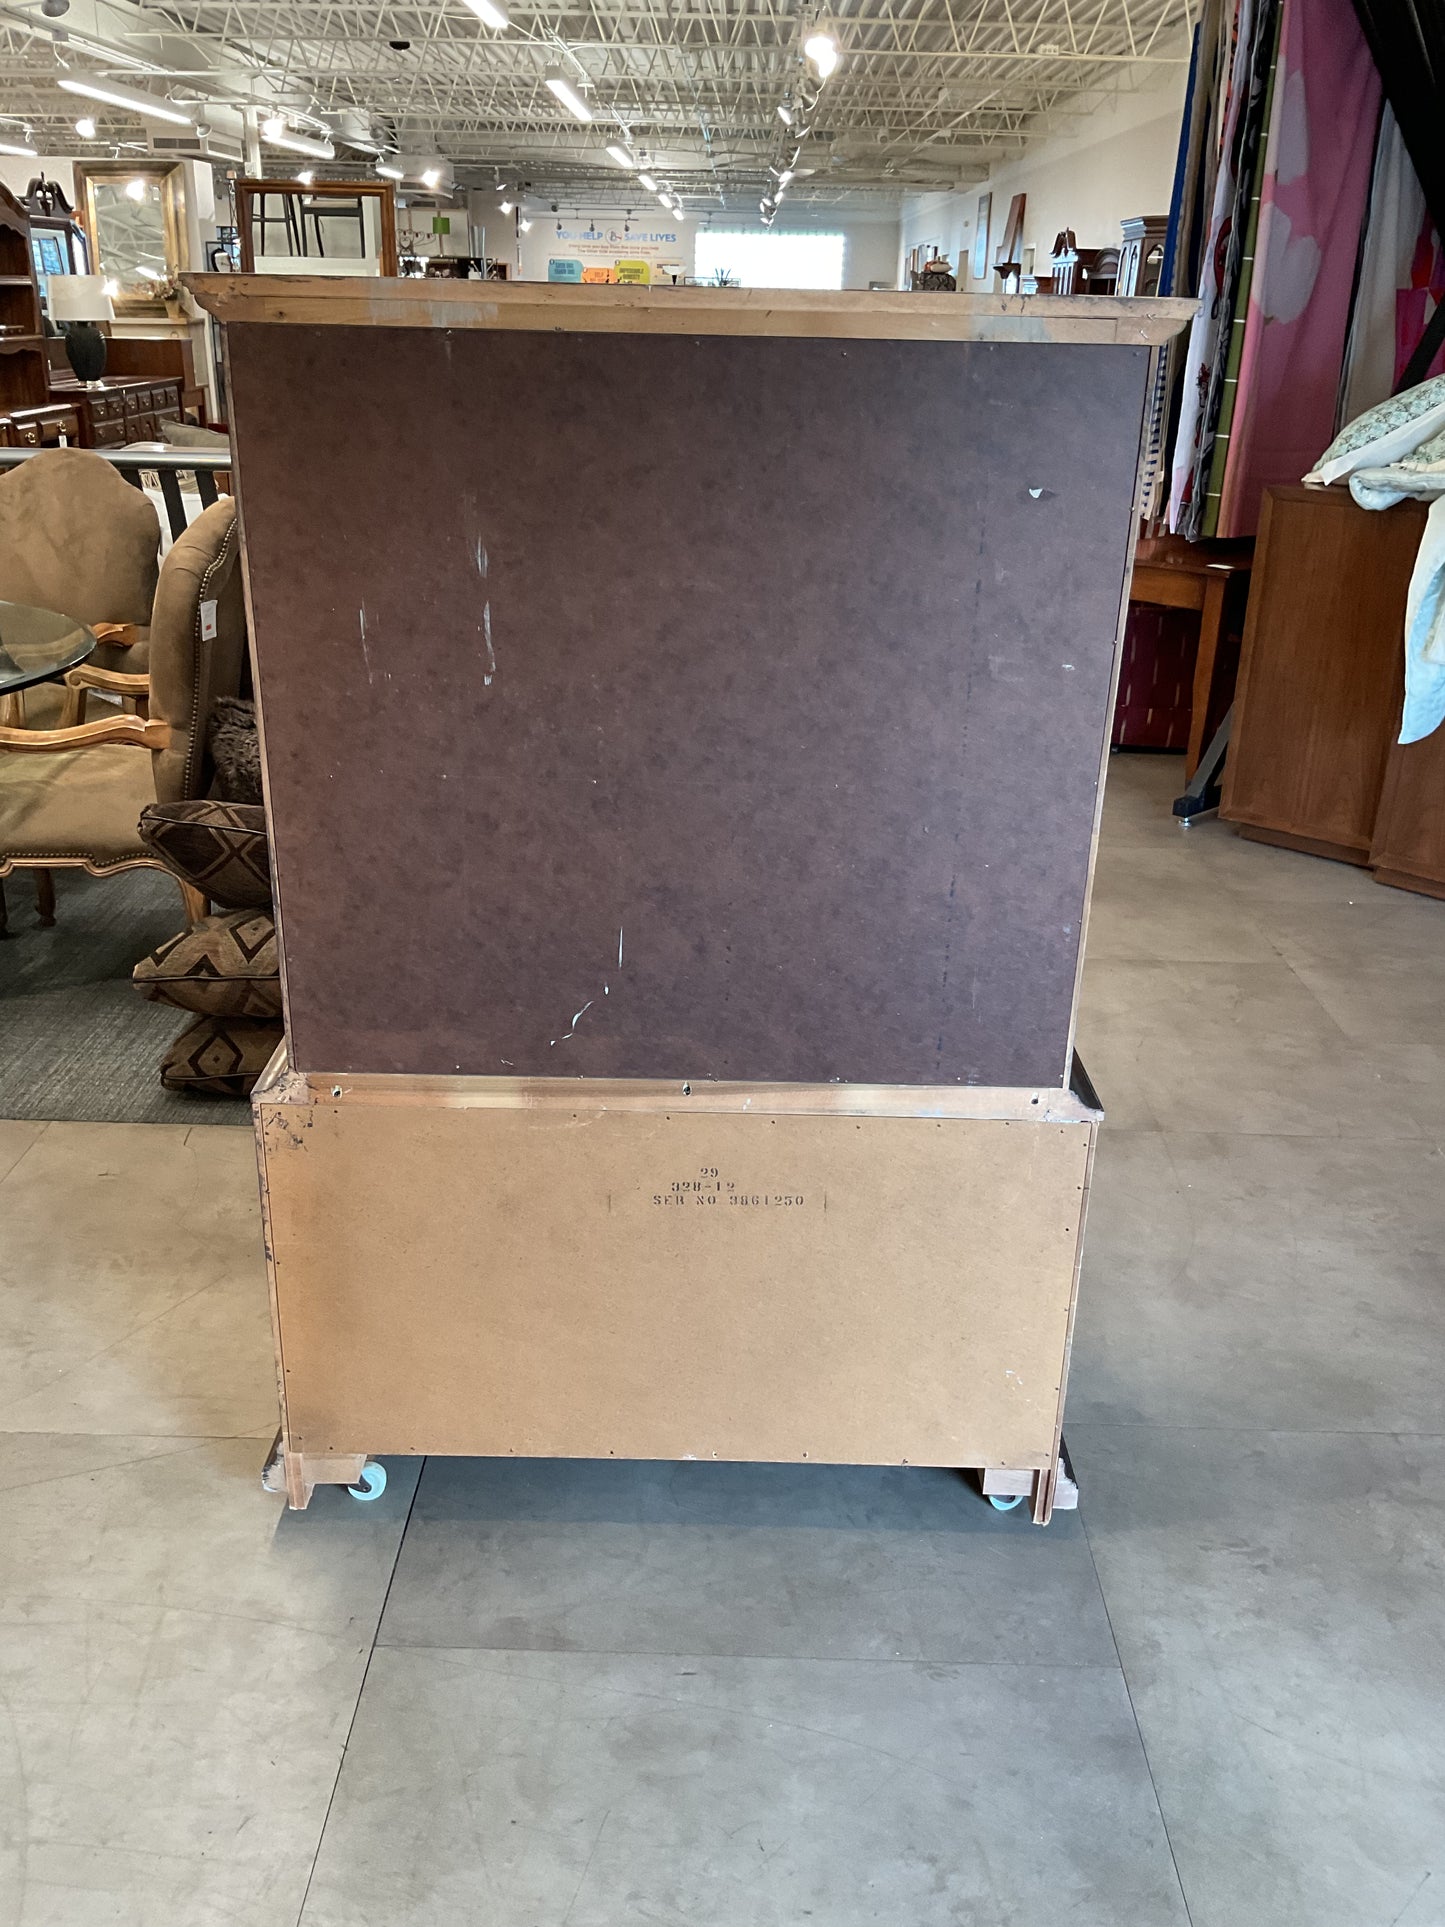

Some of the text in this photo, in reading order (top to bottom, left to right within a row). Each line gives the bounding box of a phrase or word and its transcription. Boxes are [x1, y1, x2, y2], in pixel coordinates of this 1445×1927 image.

[579, 231, 603, 241] HELP
[650, 233, 677, 243] LIVES
[700, 1167, 719, 1178] 29
[671, 1182, 735, 1192] 328-12
[696, 1195, 716, 1206] NO
[729, 1195, 804, 1206] 3861250
